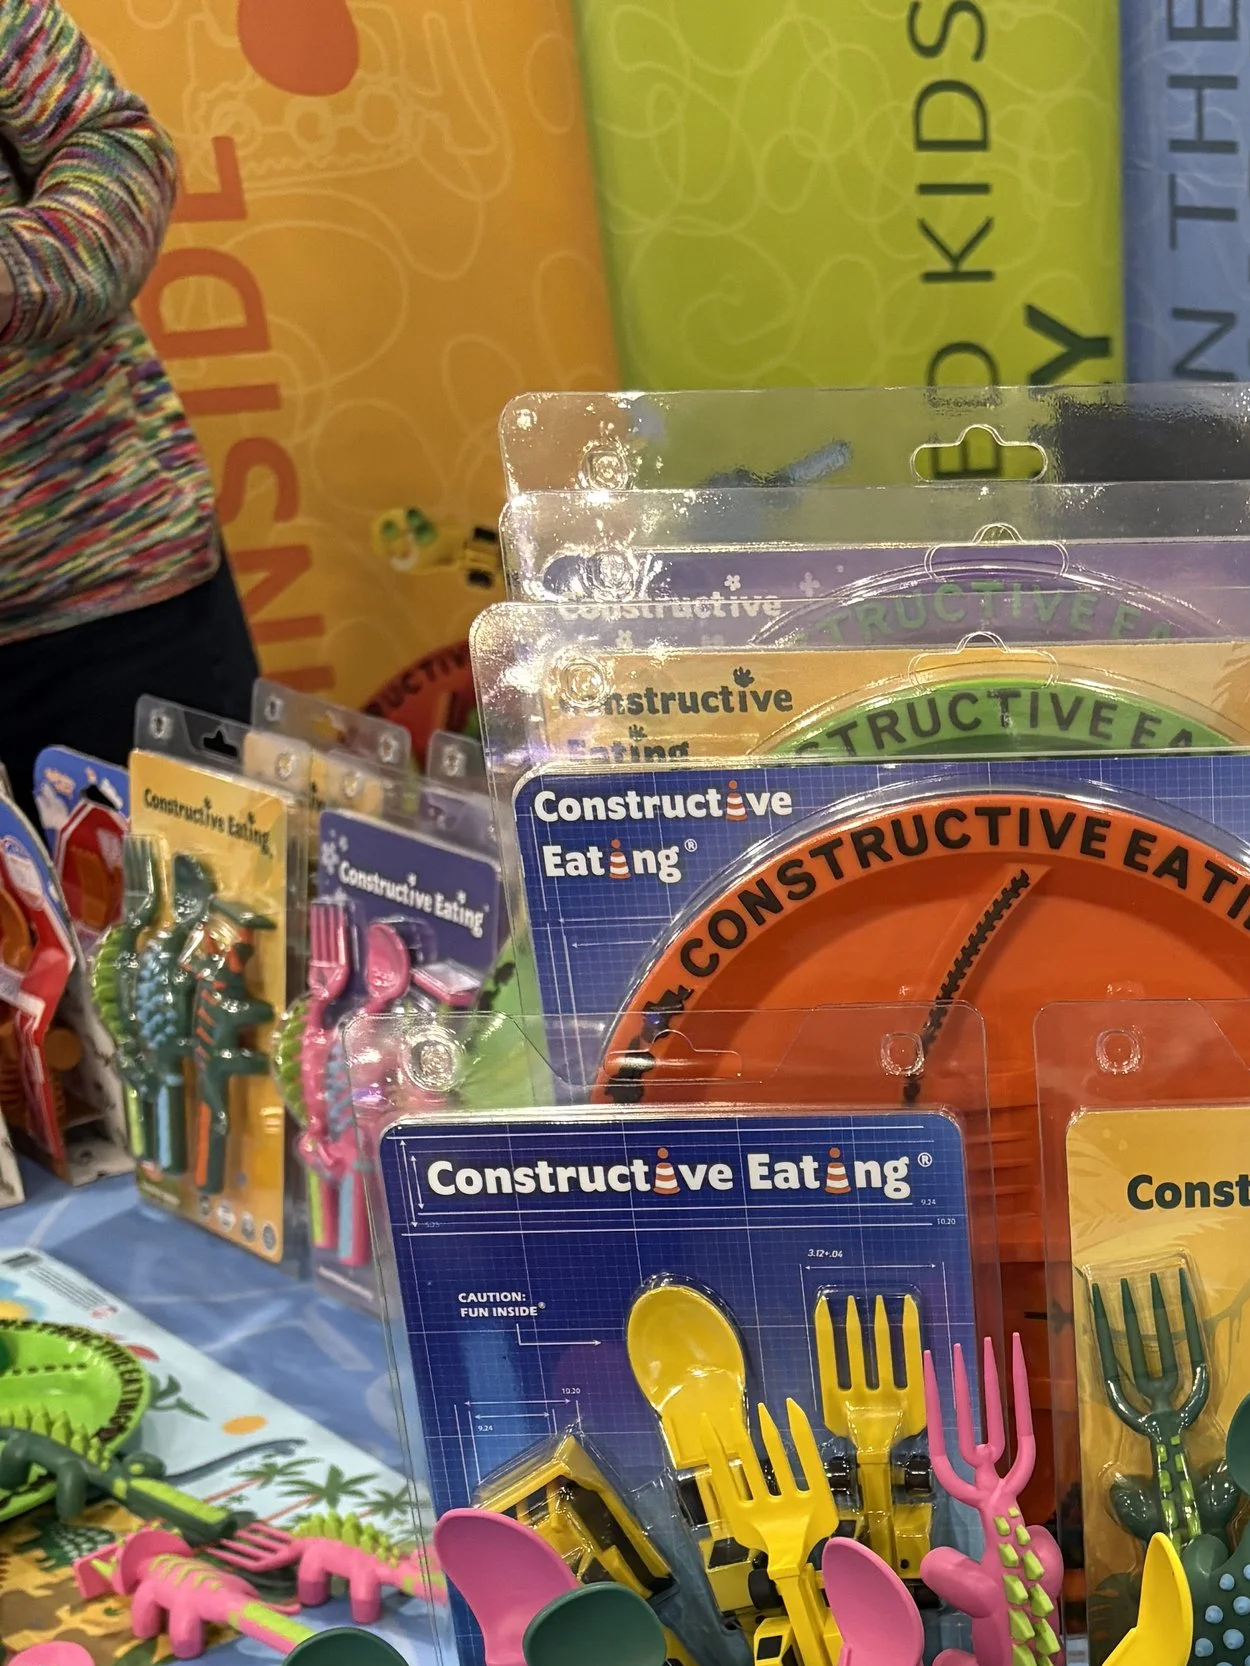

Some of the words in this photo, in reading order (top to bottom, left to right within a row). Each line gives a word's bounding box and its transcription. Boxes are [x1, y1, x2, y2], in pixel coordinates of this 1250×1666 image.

[560, 670, 793, 716] nstructive
[793, 692, 1113, 757] TRUCTIVE
[144, 787, 226, 833] Constructive
[227, 812, 271, 857] Eating
[534, 780, 792, 823] Constructive
[338, 860, 432, 914] Constructive
[434, 891, 485, 940] Eating
[680, 804, 1107, 979] CONSTRUCTIVE
[427, 1148, 733, 1197] Constructive
[936, 1217, 957, 1226] 10.20
[458, 1292, 526, 1303] CAUTION:
[461, 1308, 489, 1318] FUN
